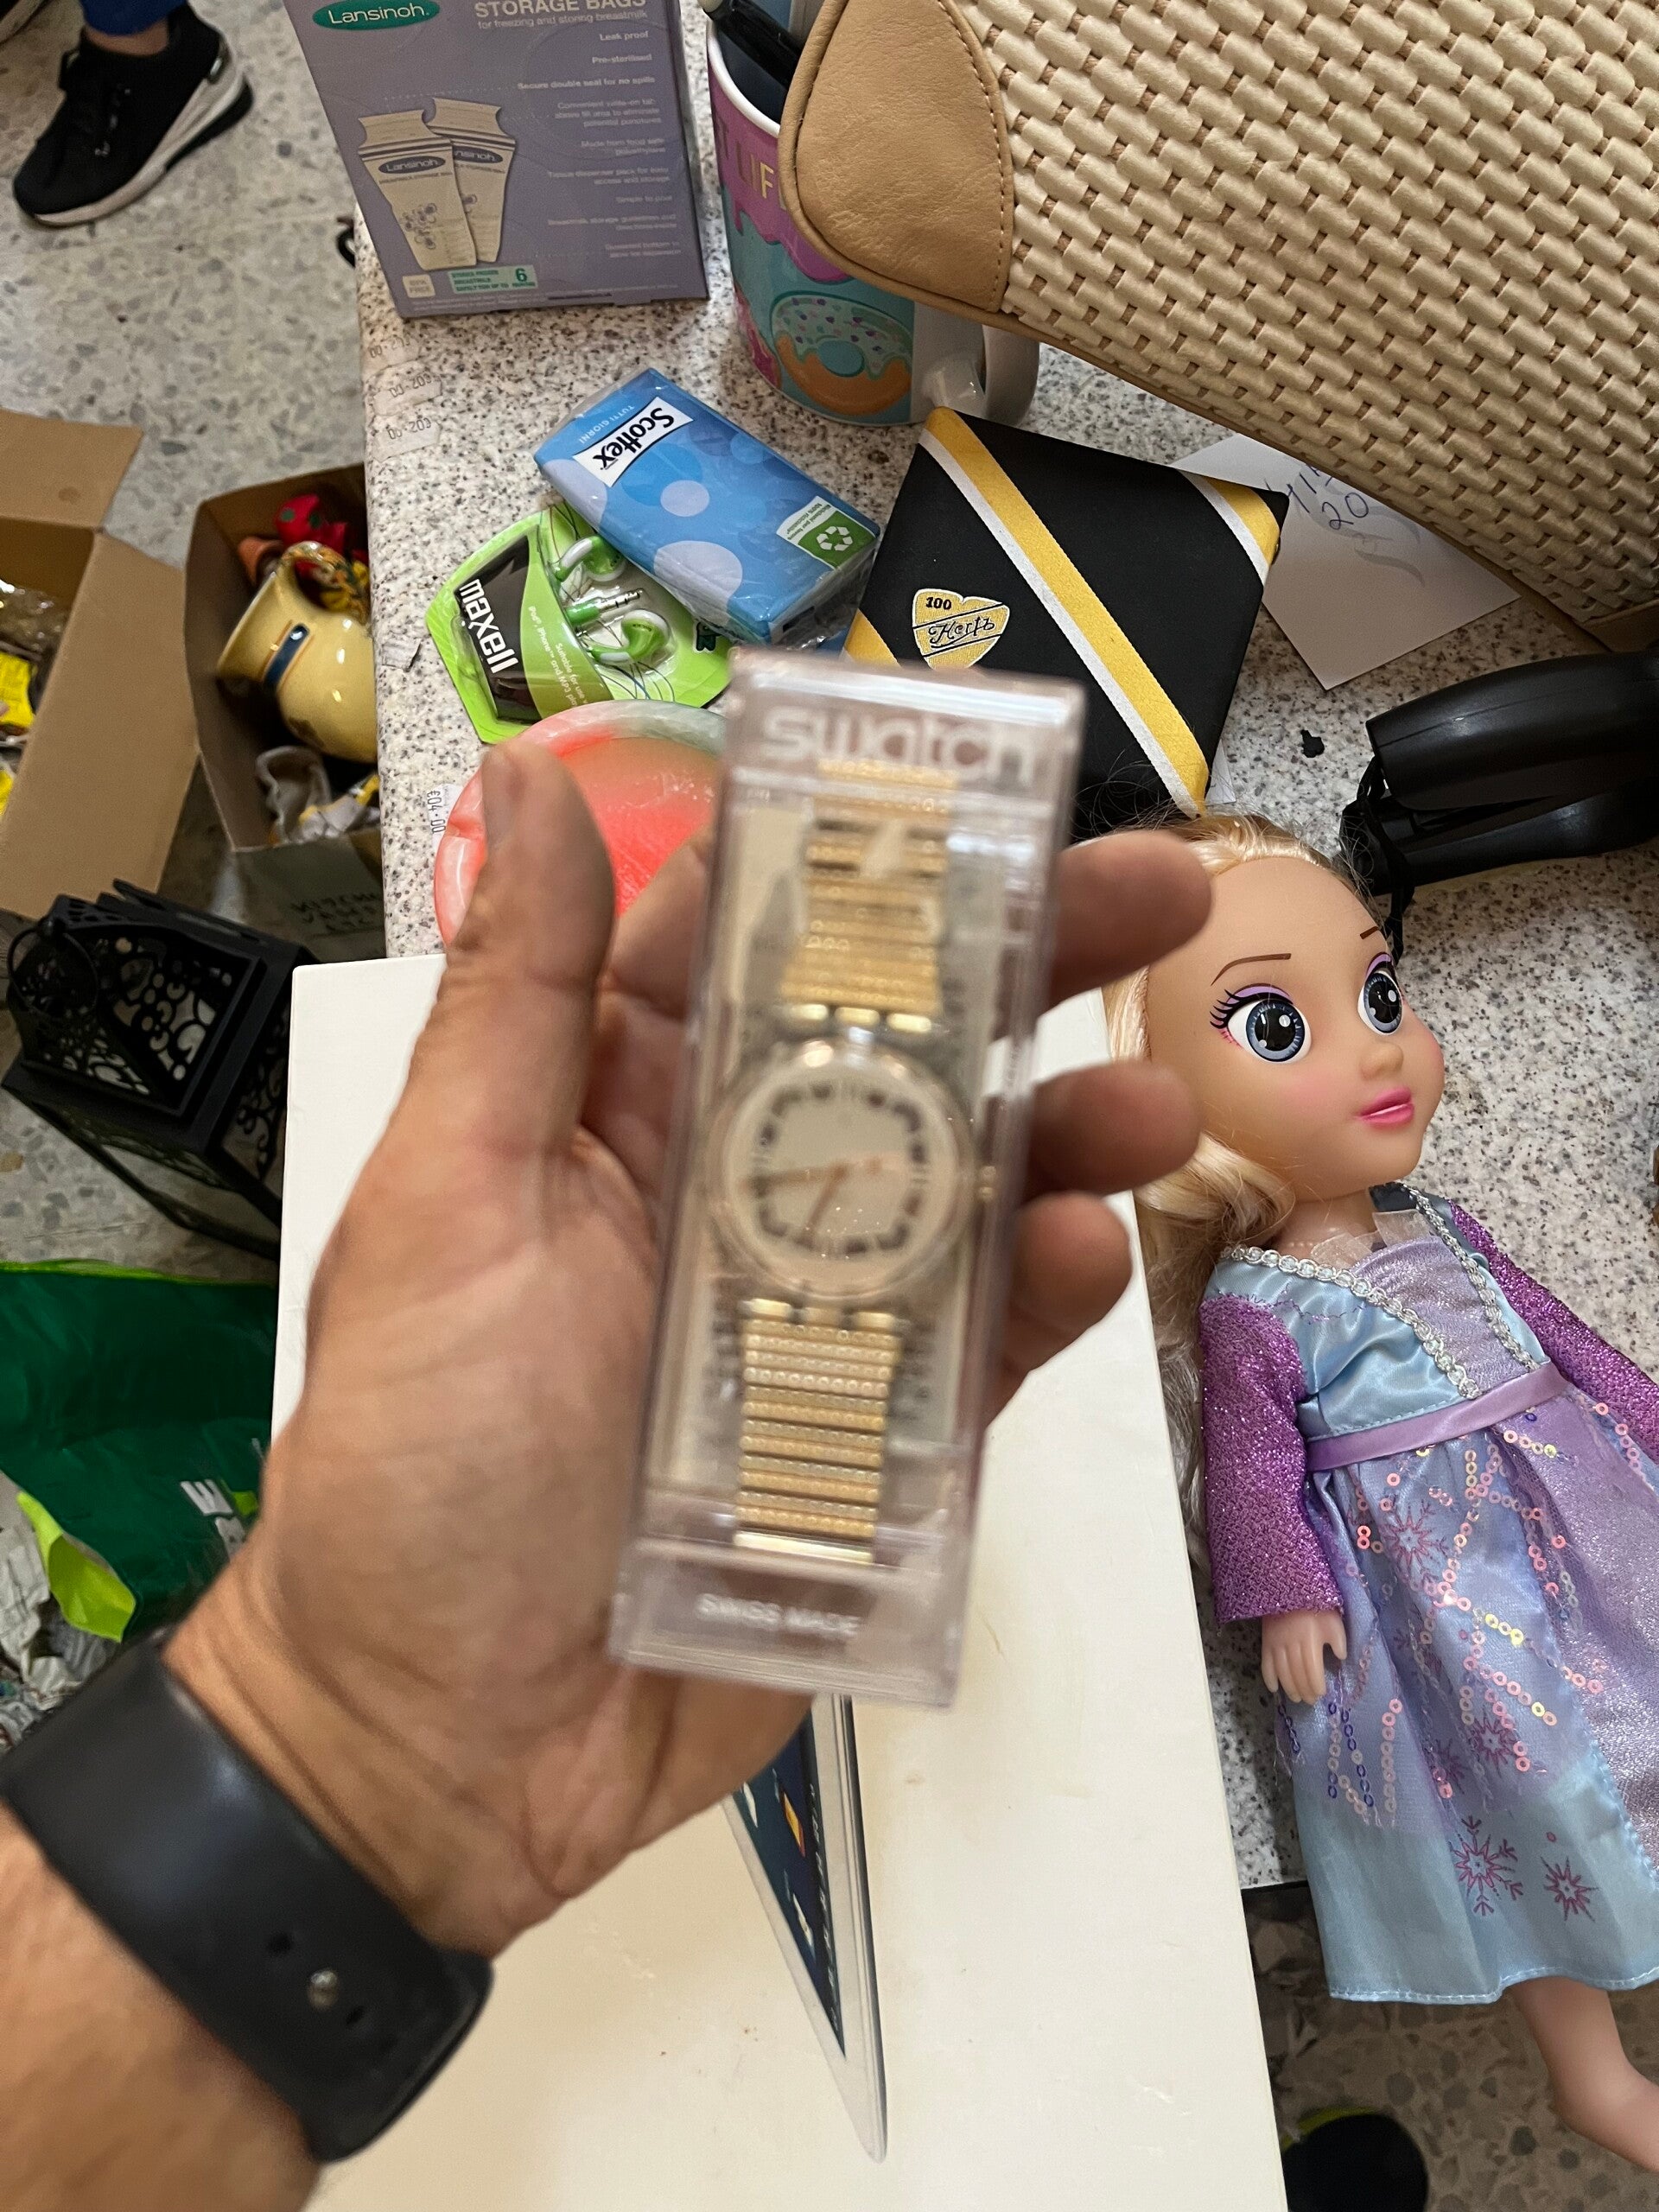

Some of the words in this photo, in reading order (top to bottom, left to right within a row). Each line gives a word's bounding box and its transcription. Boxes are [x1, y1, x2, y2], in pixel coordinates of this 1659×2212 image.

[327, 3, 425, 23] Lansinoh
[475, 0, 580, 17] STORAGE
[478, 20, 492, 29] for
[494, 18, 534, 28] freezing
[537, 16, 556, 25] and
[559, 13, 594, 24] storing
[595, 10, 648, 21] breastmilk
[599, 32, 622, 41] Leak
[624, 30, 649, 41] proof
[515, 268, 528, 282] 6
[610, 405, 636, 422] TUTTI
[578, 420, 610, 444] GIORNI
[592, 407, 675, 469] Scottex
[1322, 492, 1369, 530] 20
[925, 596, 952, 611] 100
[459, 578, 518, 674] maxell
[551, 659, 563, 676] and
[558, 676, 572, 694] MP3
[760, 705, 1035, 784] swatch
